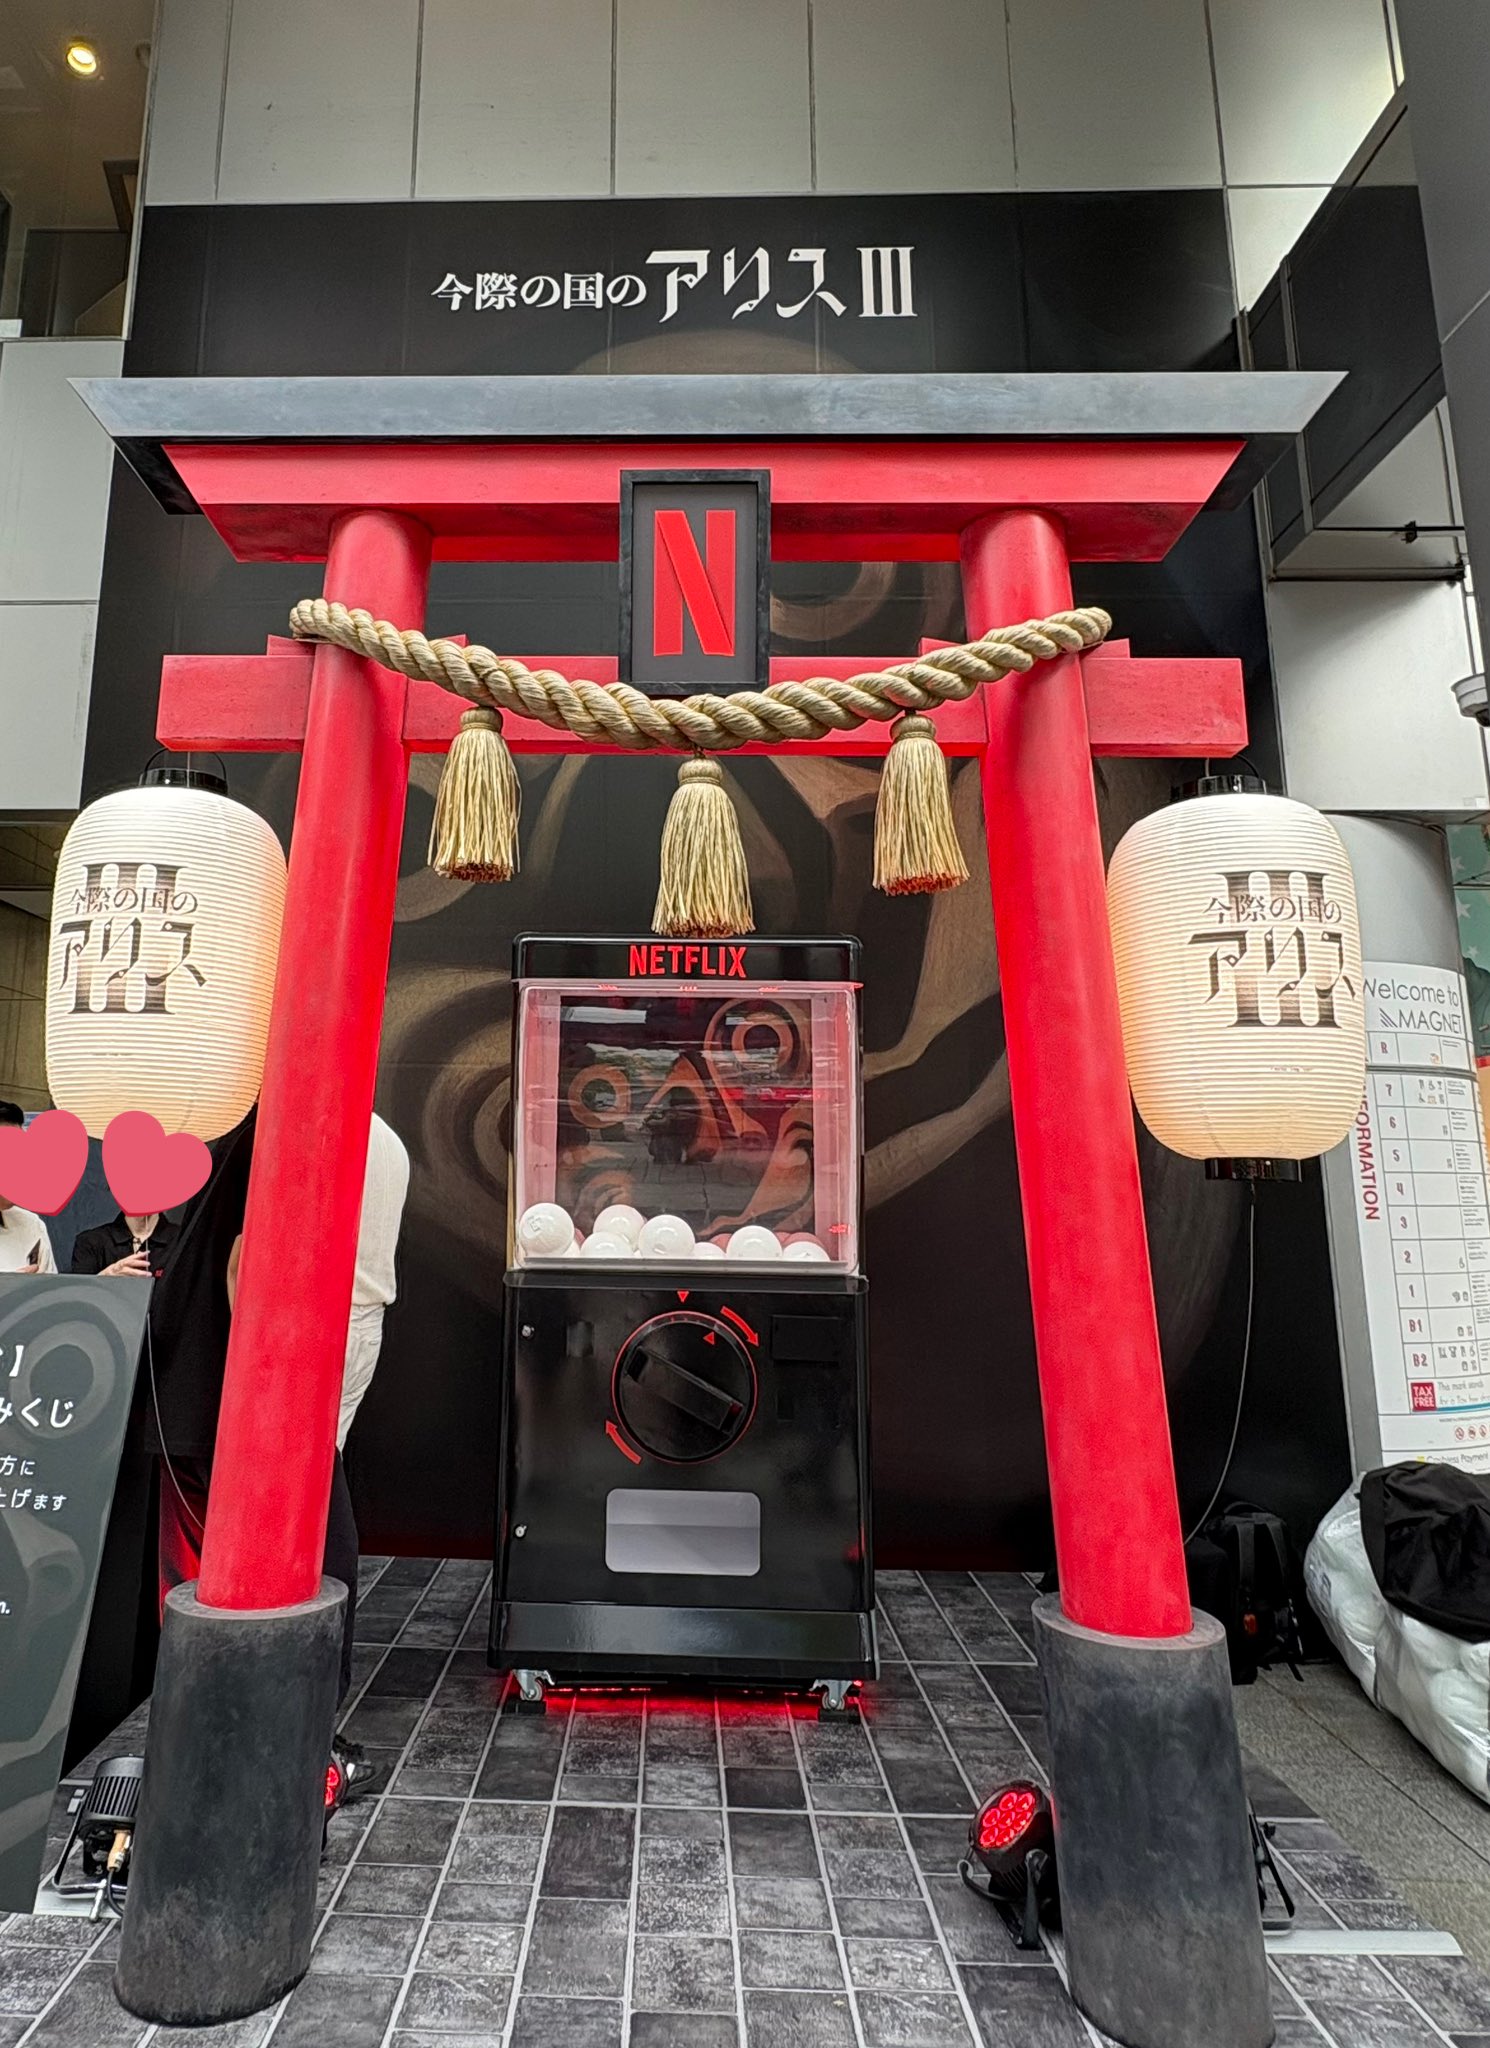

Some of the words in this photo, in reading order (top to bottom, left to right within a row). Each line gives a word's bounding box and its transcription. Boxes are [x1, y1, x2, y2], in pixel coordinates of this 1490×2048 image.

[653, 509, 737, 657] N
[68, 886, 199, 915] 今際の国の
[1202, 893, 1343, 925] 今際の国の
[58, 916, 208, 991] アリス
[628, 945, 748, 978] NETFLIX
[1187, 926, 1356, 1005] アリス
[1362, 978, 1446, 1005] Welcome
[1446, 985, 1460, 1008] to
[1380, 1041, 1389, 1055] R
[1385, 1083, 1393, 1097] 7
[1389, 1115, 1397, 1129] 6
[1355, 1080, 1381, 1221] FORMATION
[1392, 1148, 1400, 1162] 5
[1396, 1182, 1405, 1196] 4
[1400, 1215, 1408, 1229] 3
[1403, 1250, 1412, 1264] 2
[1408, 1284, 1415, 1298] 1
[1408, 1319, 1423, 1333] B1
[1412, 1353, 1428, 1367] B2
[1413, 1385, 1433, 1396] TAX
[1414, 1396, 1435, 1408] FREE
